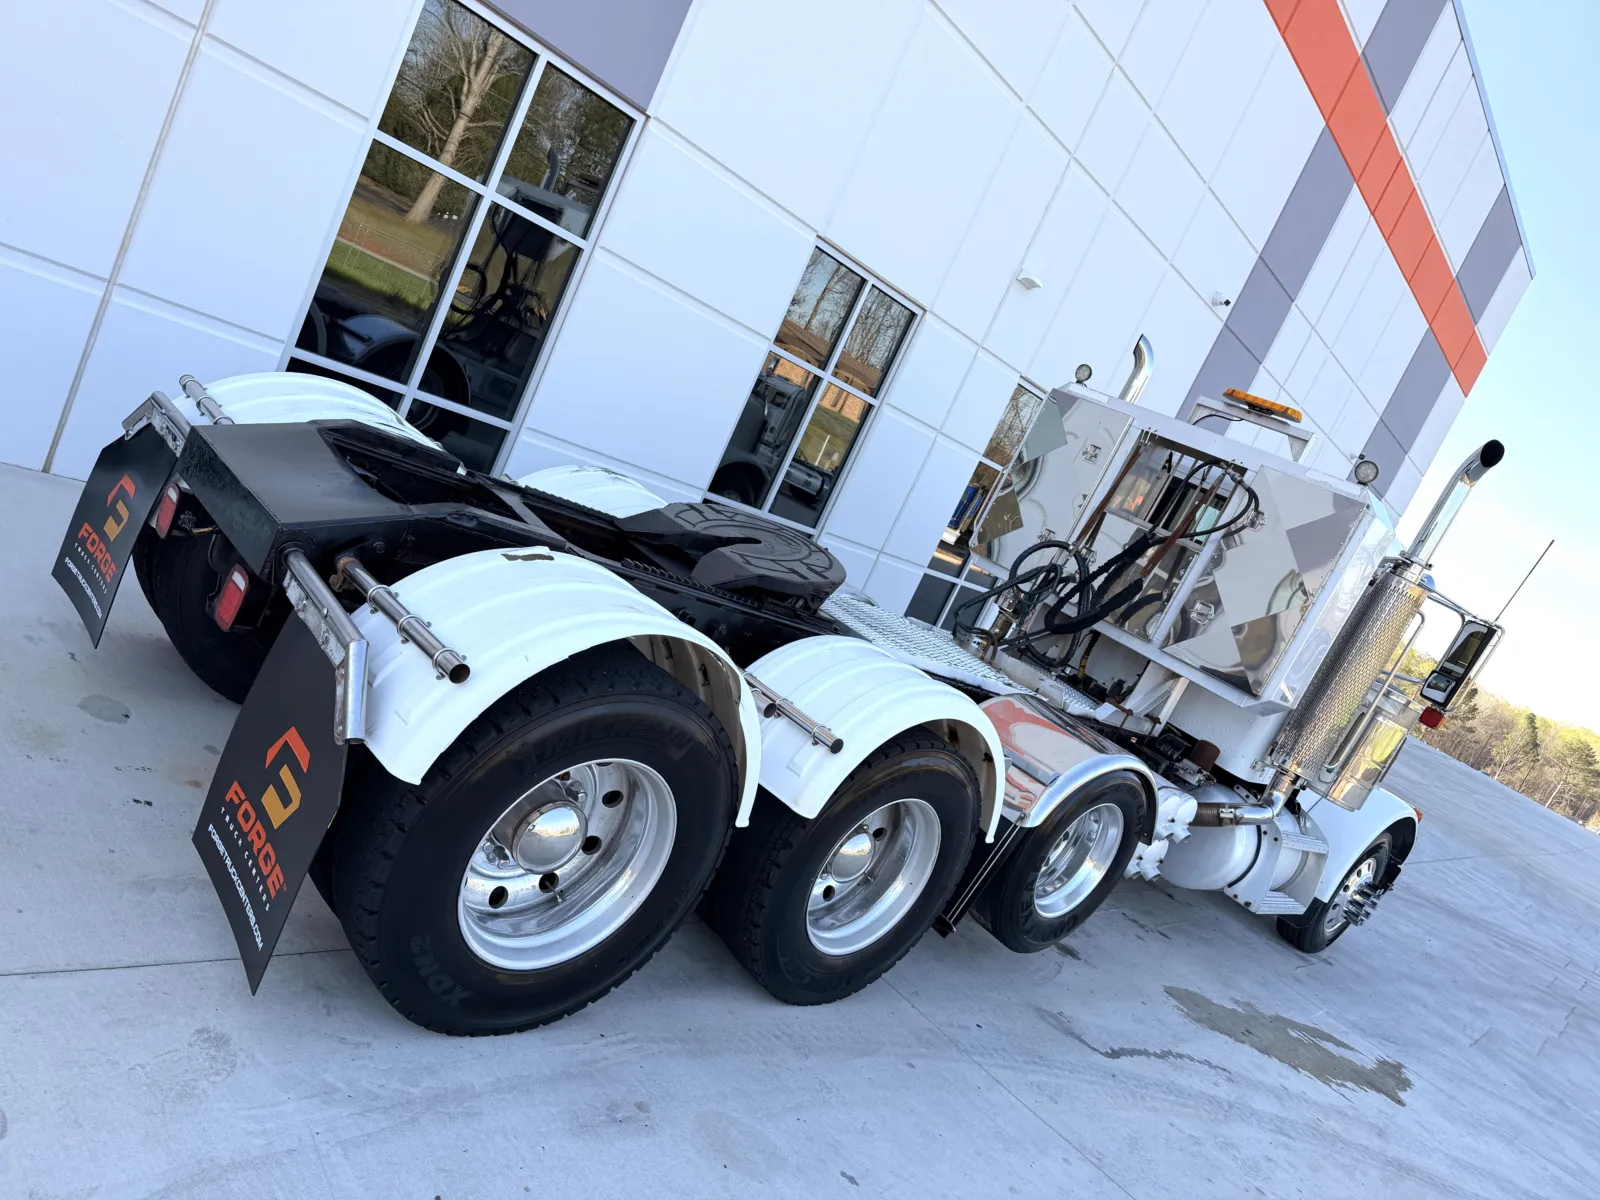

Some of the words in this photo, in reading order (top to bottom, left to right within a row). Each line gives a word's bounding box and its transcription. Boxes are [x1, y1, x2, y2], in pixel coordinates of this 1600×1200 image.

[78, 522, 117, 585] FORGE
[207, 823, 265, 952] FORGETRUCKCENTERS.COM
[220, 806, 243, 848] TRUCK
[243, 851, 271, 911] CENTERS
[225, 779, 285, 900] FORGE
